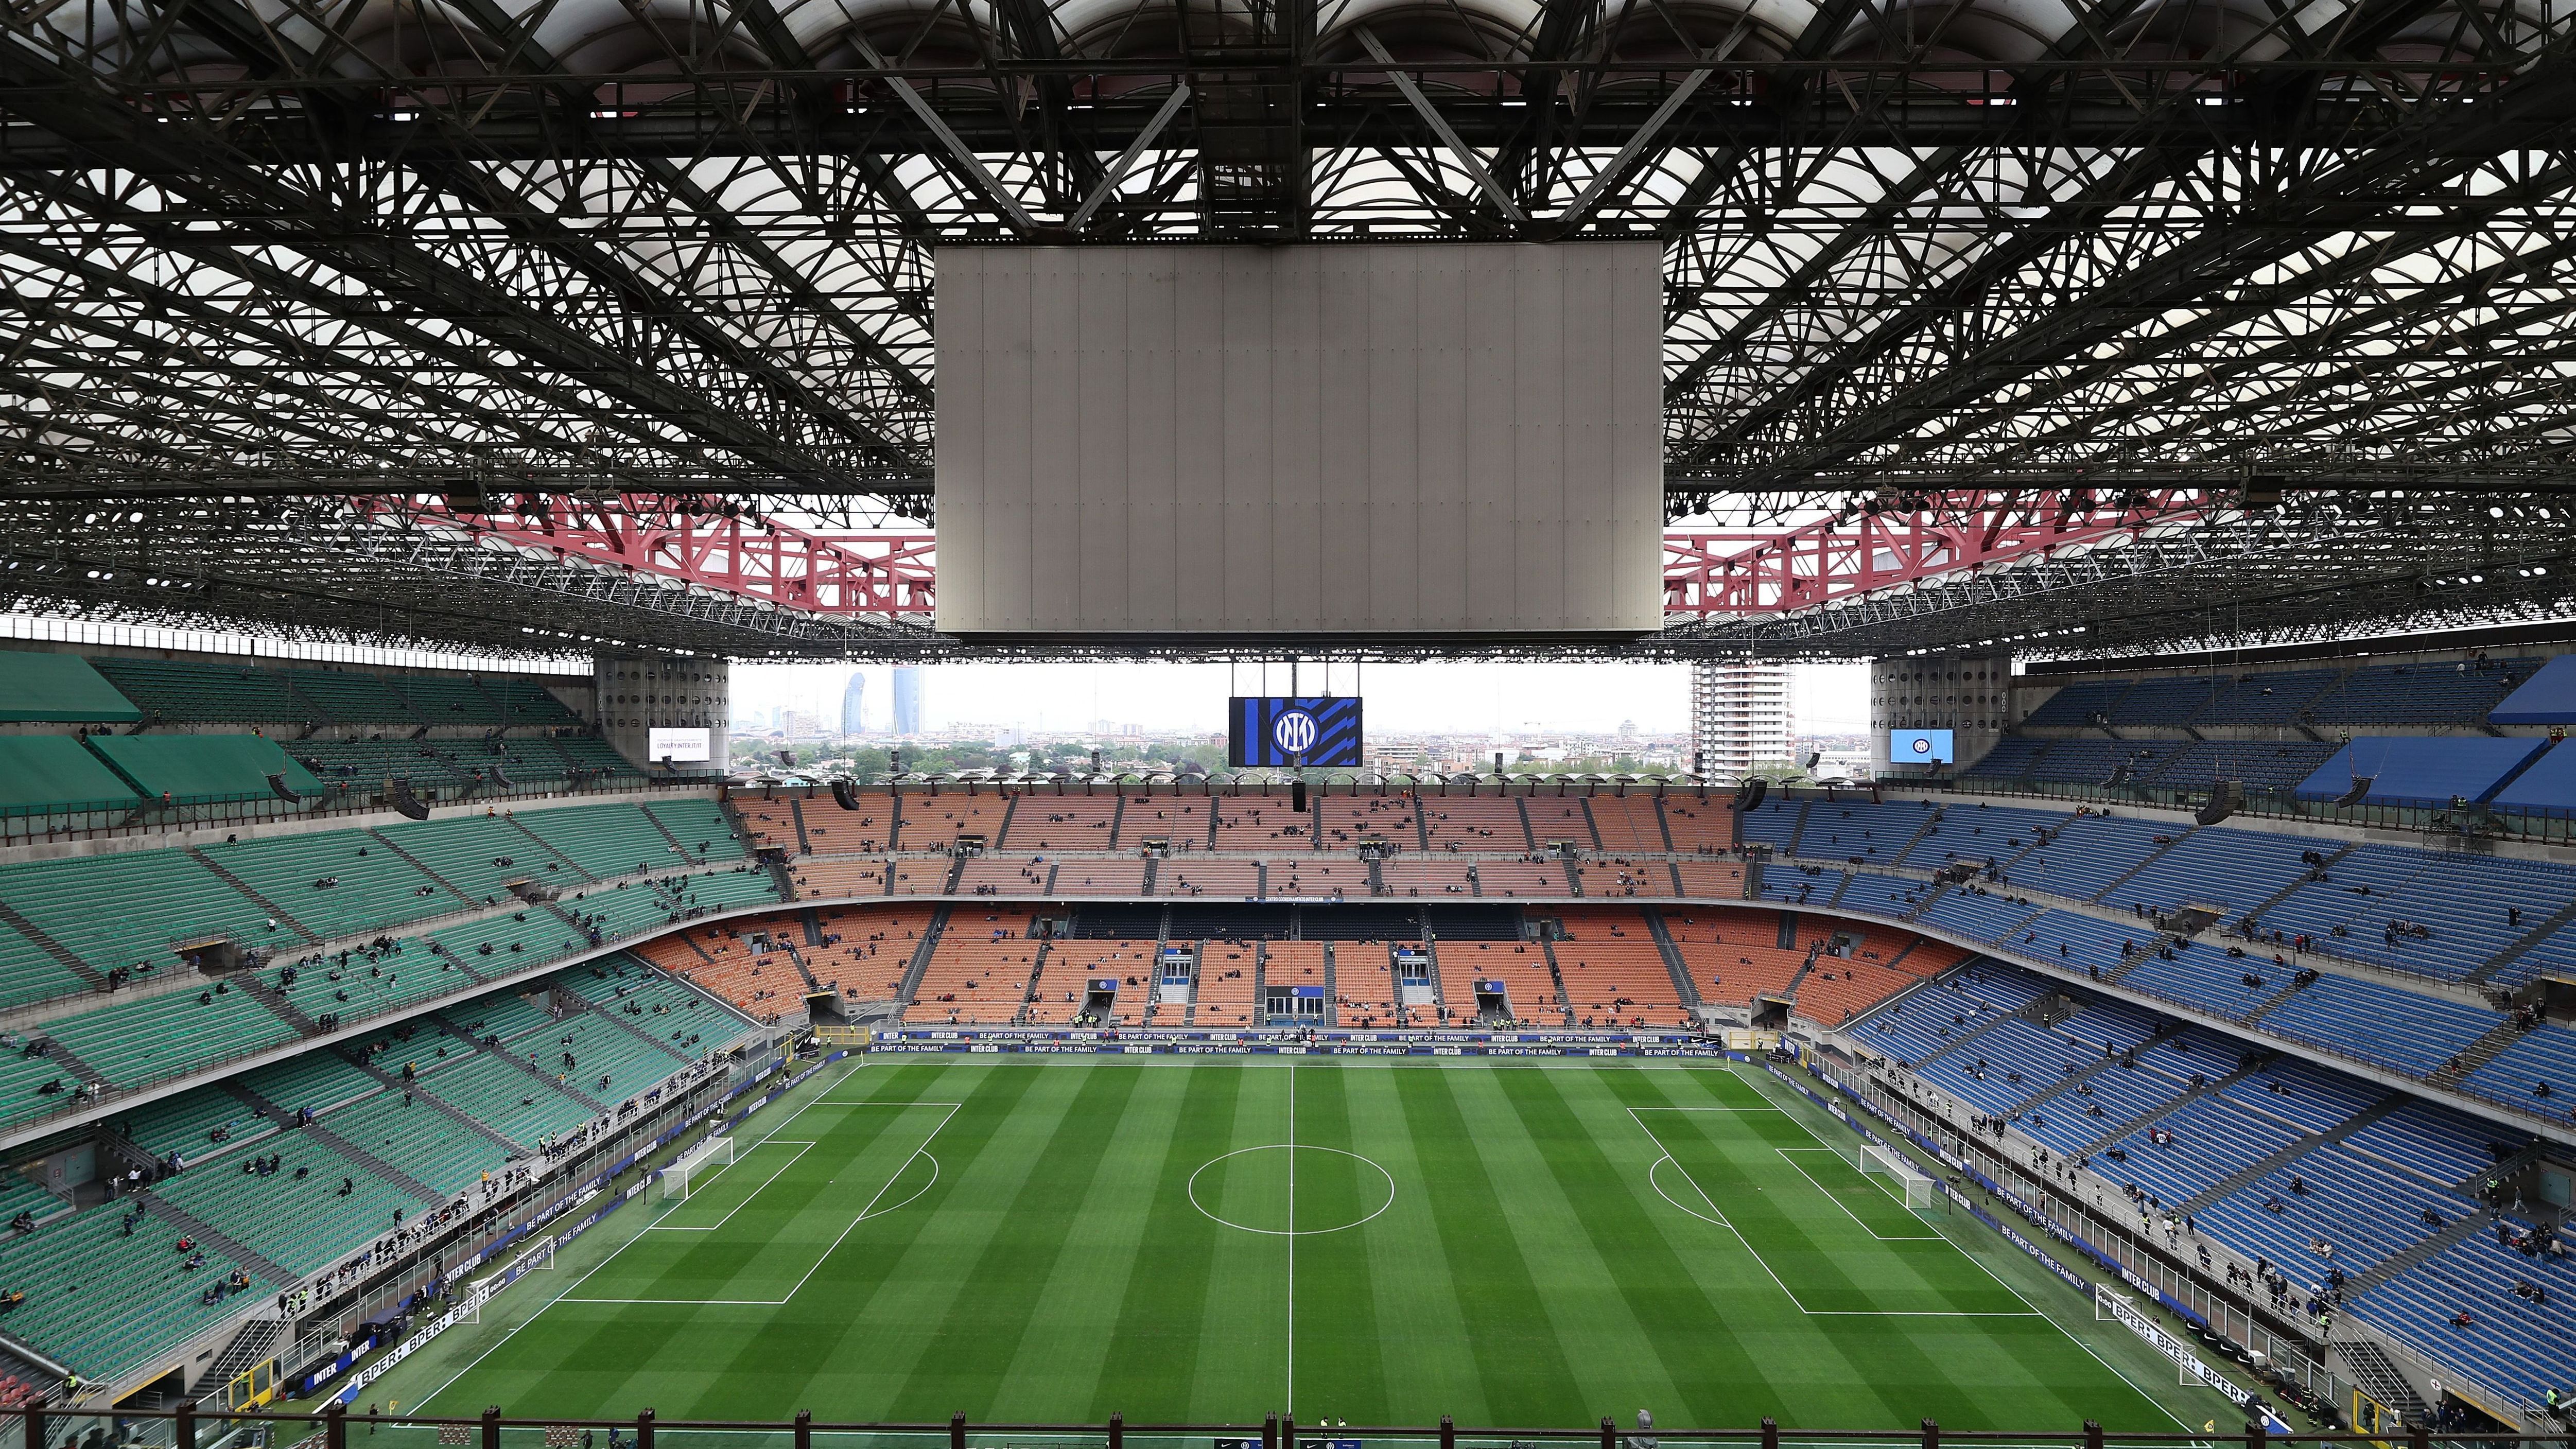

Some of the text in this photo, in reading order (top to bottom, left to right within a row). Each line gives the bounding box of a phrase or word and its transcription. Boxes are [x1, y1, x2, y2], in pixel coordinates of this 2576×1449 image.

[1784, 1039, 1795, 1055] INTER
[791, 1076, 800, 1086] PART
[812, 1060, 826, 1073] FAMILY
[1774, 1069, 1782, 1078] PART
[1796, 1083, 1808, 1095] FAMILY
[1822, 1073, 1831, 1084] INTER
[749, 1096, 767, 1114] INTER CLUB
[1828, 1102, 1846, 1121] INTER CLUB
[685, 1119, 692, 1128] BE
[692, 1112, 702, 1124] PART
[1867, 1102, 1877, 1113] PART
[1885, 1113, 1893, 1124] THE
[1893, 1120, 1910, 1135] FAMILY
[634, 1140, 657, 1161] INTER CLUB
[677, 1122, 729, 1163] BE PART OF FAMILY
[1866, 1130, 1919, 1172] BE PART THE FAMILY
[1940, 1149, 1963, 1171] INTER CLUB
[627, 1183, 639, 1199] INTER
[1958, 1194, 1970, 1210] CLUB
[527, 1177, 601, 1231] BE PART OF THE FAMILY
[1997, 1187, 2074, 1243] BE PART OF THE FAMILY
[516, 1214, 596, 1276] BE PART THE FAMILY
[446, 1253, 481, 1282] NTER CLUB
[2002, 1225, 2084, 1289] BE PART OF THE FAMILY
[490, 1278, 506, 1292] 00:00
[2122, 1267, 2160, 1300] INTER CLUB
[2098, 1295, 2111, 1308] 0:00
[352, 1340, 370, 1361] INTER
[314, 1363, 337, 1385] INTER
